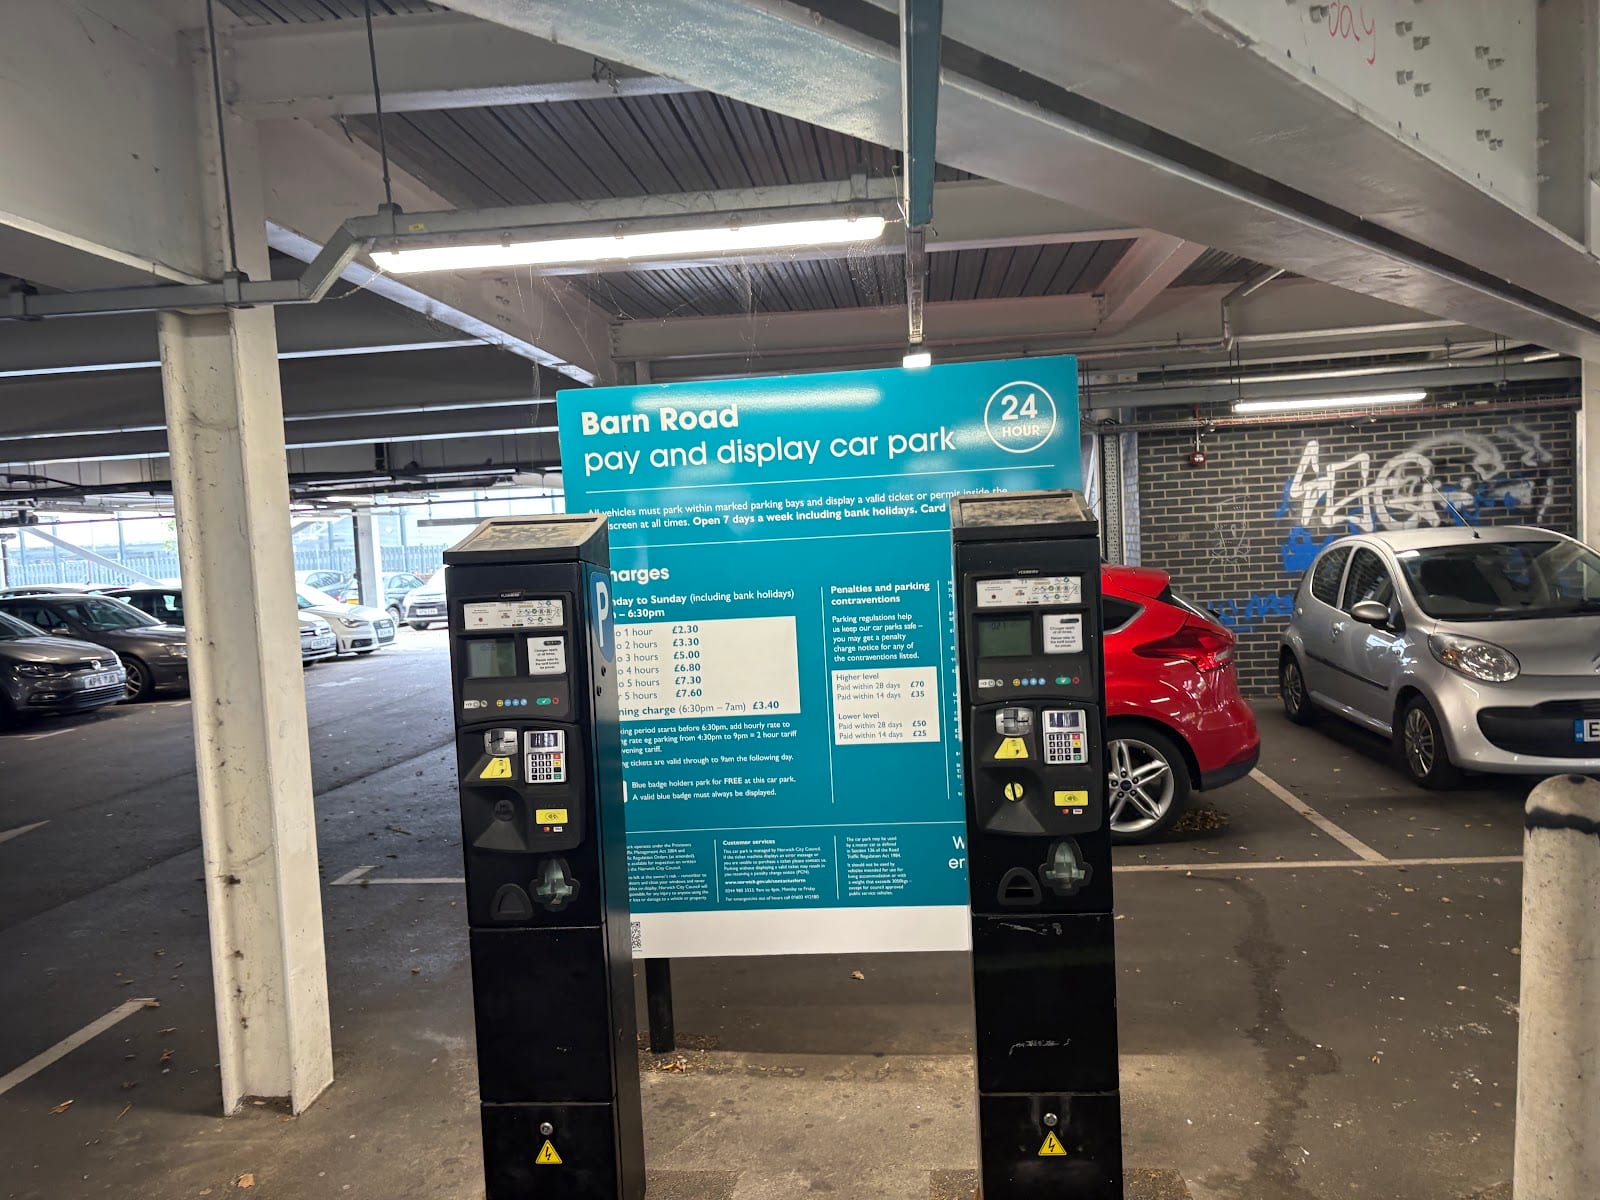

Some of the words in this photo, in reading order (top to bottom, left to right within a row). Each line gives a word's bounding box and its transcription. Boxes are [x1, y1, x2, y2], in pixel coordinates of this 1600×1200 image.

[1001, 393, 1038, 421] 24
[581, 409, 650, 436] Barn
[659, 404, 740, 432] Road
[1002, 424, 1040, 437] HOUR
[583, 448, 641, 477] pay
[649, 440, 708, 469] and
[716, 435, 821, 468] display
[829, 433, 880, 458] car
[888, 425, 957, 460] park
[602, 507, 636, 517] vehicles
[663, 505, 683, 516] park
[685, 503, 713, 513] within
[715, 501, 749, 511] marked
[751, 500, 784, 512] parking
[785, 499, 805, 509] bays
[807, 497, 823, 507] and
[825, 496, 856, 507] display
[865, 493, 886, 503] valid
[888, 493, 914, 502] ticket
[916, 493, 928, 501] or
[608, 522, 638, 531] screen
[640, 521, 650, 529] at
[652, 518, 661, 528] all
[664, 516, 690, 527] times.
[693, 516, 721, 528] Open
[723, 514, 730, 524] 7
[732, 514, 756, 525] days
[758, 515, 765, 523] a
[766, 509, 794, 522] week
[796, 510, 842, 521] including
[844, 508, 870, 518] bank
[872, 506, 918, 516] holidays.
[920, 503, 946, 513] Card
[831, 585, 873, 594] Penalties
[875, 583, 892, 592] and
[895, 582, 930, 593] parking
[636, 597, 648, 605] to
[651, 594, 687, 605] Sunday
[690, 592, 732, 604] (including
[733, 591, 755, 600] bank
[757, 589, 795, 600] holidays)
[831, 596, 901, 605] contraventions
[596, 581, 609, 648] P
[627, 608, 665, 620] 6:30pm
[832, 616, 858, 624] Parking
[859, 614, 896, 623] regulations
[897, 613, 913, 621] help
[625, 628, 629, 636] 1
[632, 627, 653, 637] hour
[672, 624, 699, 634] £2.30
[842, 625, 858, 634] keep
[884, 623, 903, 632] parks
[904, 622, 917, 630] safe
[625, 641, 631, 649] 2
[633, 640, 658, 649] hours
[673, 637, 700, 647] £3.30
[863, 635, 874, 643] get
[881, 633, 907, 642] penalty
[834, 645, 856, 654] charge
[881, 643, 892, 651] for
[893, 644, 905, 652] any
[906, 642, 914, 650] of
[626, 653, 631, 662] 3
[634, 652, 659, 662] hours
[673, 650, 700, 660] £5.00
[847, 654, 898, 662] contraventions
[626, 666, 632, 674] 4
[634, 664, 660, 674] hours
[674, 663, 701, 673] £6.80
[627, 679, 633, 687] 5
[635, 678, 660, 688] hours
[675, 676, 702, 685] £7.30
[836, 674, 861, 683] Higher
[863, 672, 880, 680] level
[837, 683, 851, 691] Paid
[875, 681, 884, 690] 28
[886, 682, 901, 691] days
[624, 691, 630, 700] 5
[633, 690, 658, 700] hours
[675, 688, 703, 698] £7.60
[837, 693, 852, 701] Paid
[876, 692, 885, 700] 14
[886, 692, 901, 700] days
[642, 706, 676, 716] charge
[679, 704, 714, 715] (6:30pm
[725, 702, 746, 712] 7am)
[753, 700, 780, 710] £3.40
[634, 727, 656, 736] period
[744, 722, 766, 730] hourly
[839, 722, 853, 730] Paid
[877, 721, 886, 729] 28
[888, 722, 903, 730] days
[653, 736, 679, 745] parking
[697, 733, 723, 742] 4:30pm
[733, 732, 749, 741] 9pm
[756, 731, 762, 739] 2
[781, 730, 797, 738] tariff
[840, 732, 854, 740] Paid
[888, 731, 904, 739] days
[683, 757, 710, 766] through
[749, 754, 780, 763] following
[781, 754, 794, 762] day.
